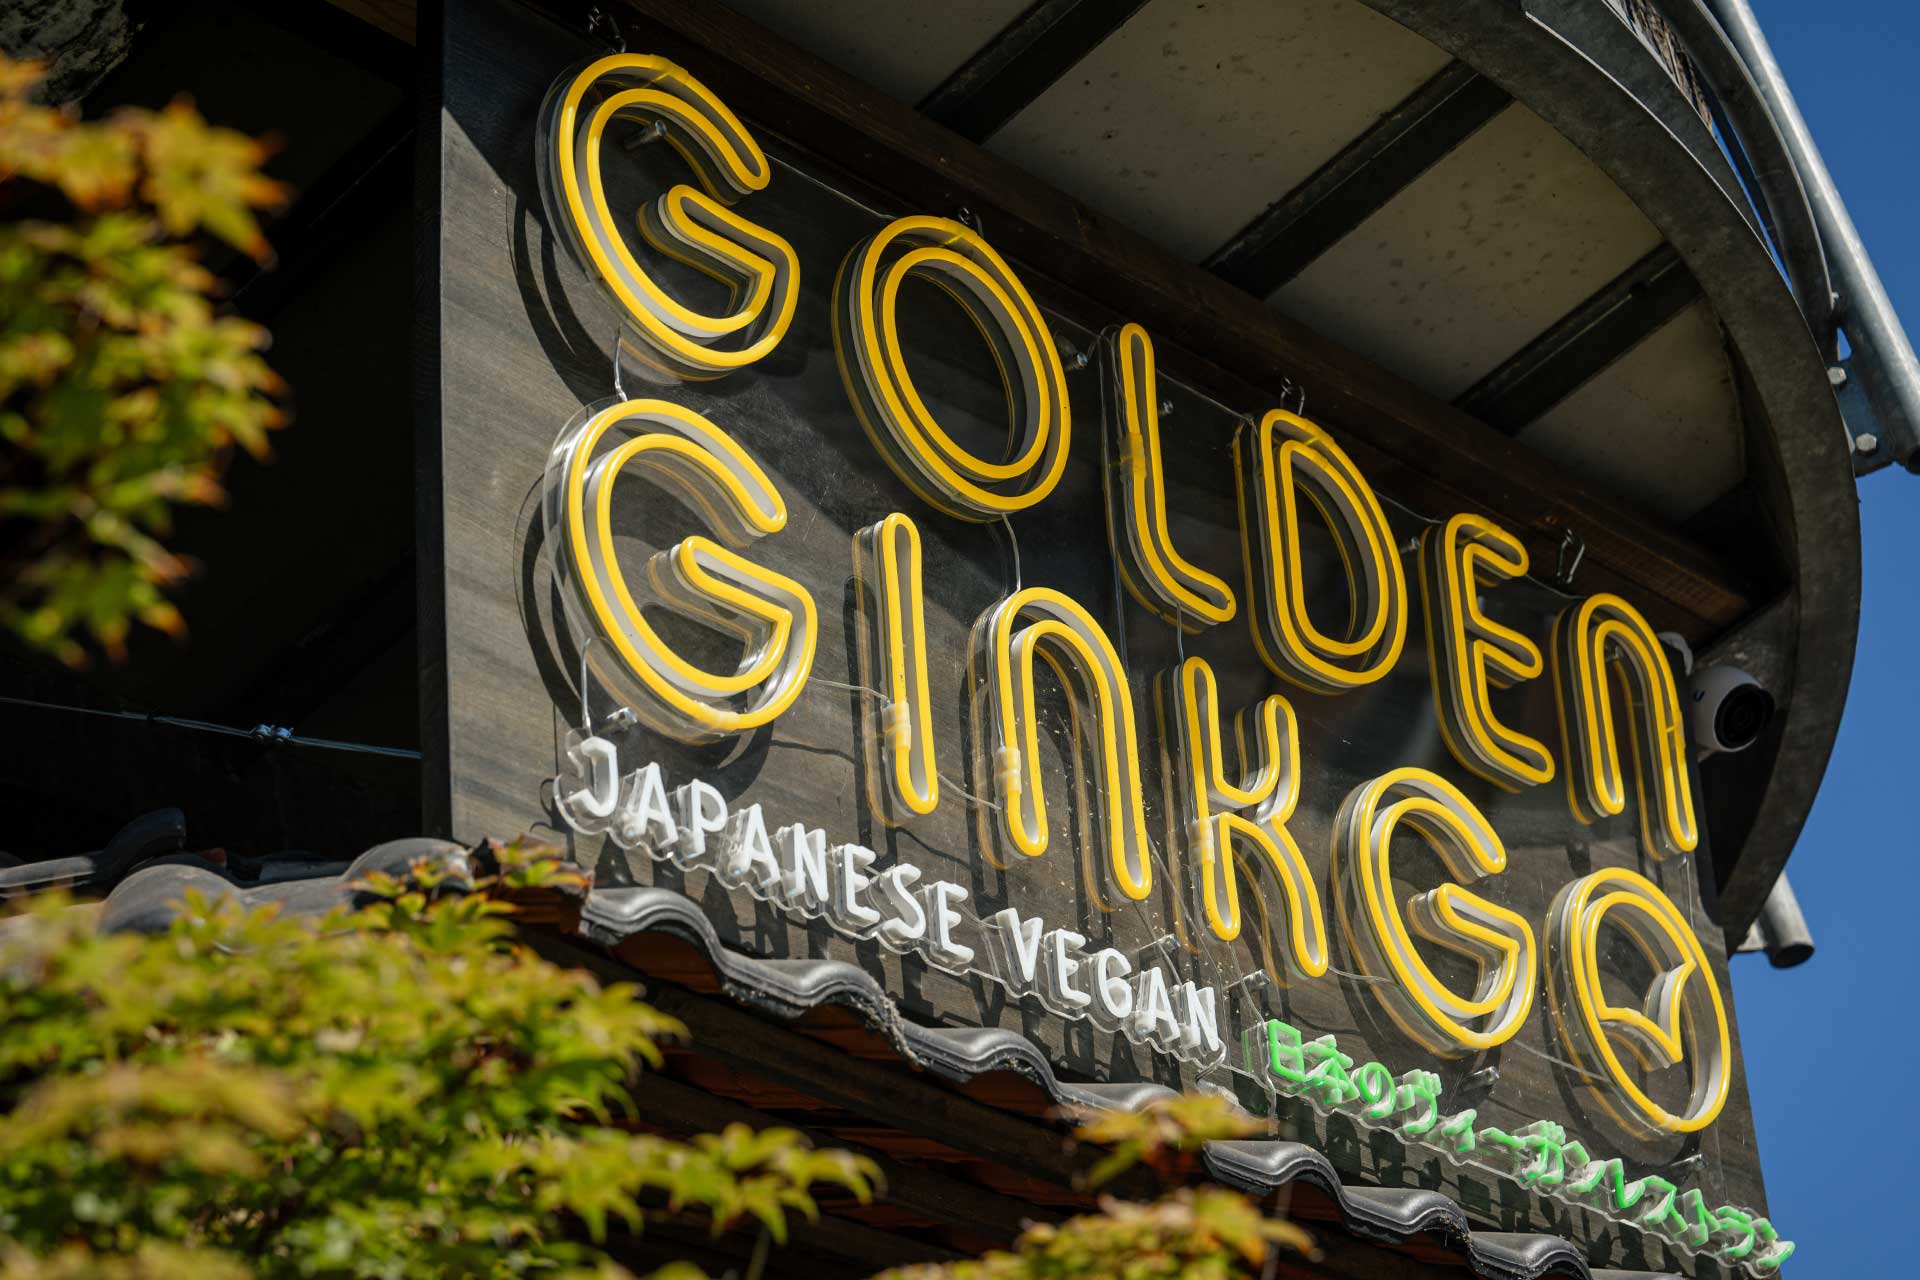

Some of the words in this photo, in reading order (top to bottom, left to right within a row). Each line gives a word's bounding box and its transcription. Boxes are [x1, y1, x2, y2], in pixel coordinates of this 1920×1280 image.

[557, 53, 1698, 852] GOLDEN
[565, 398, 1730, 1133] GINKGO
[568, 736, 974, 964] JAPANESE
[1000, 908, 1223, 1052] VEGAN
